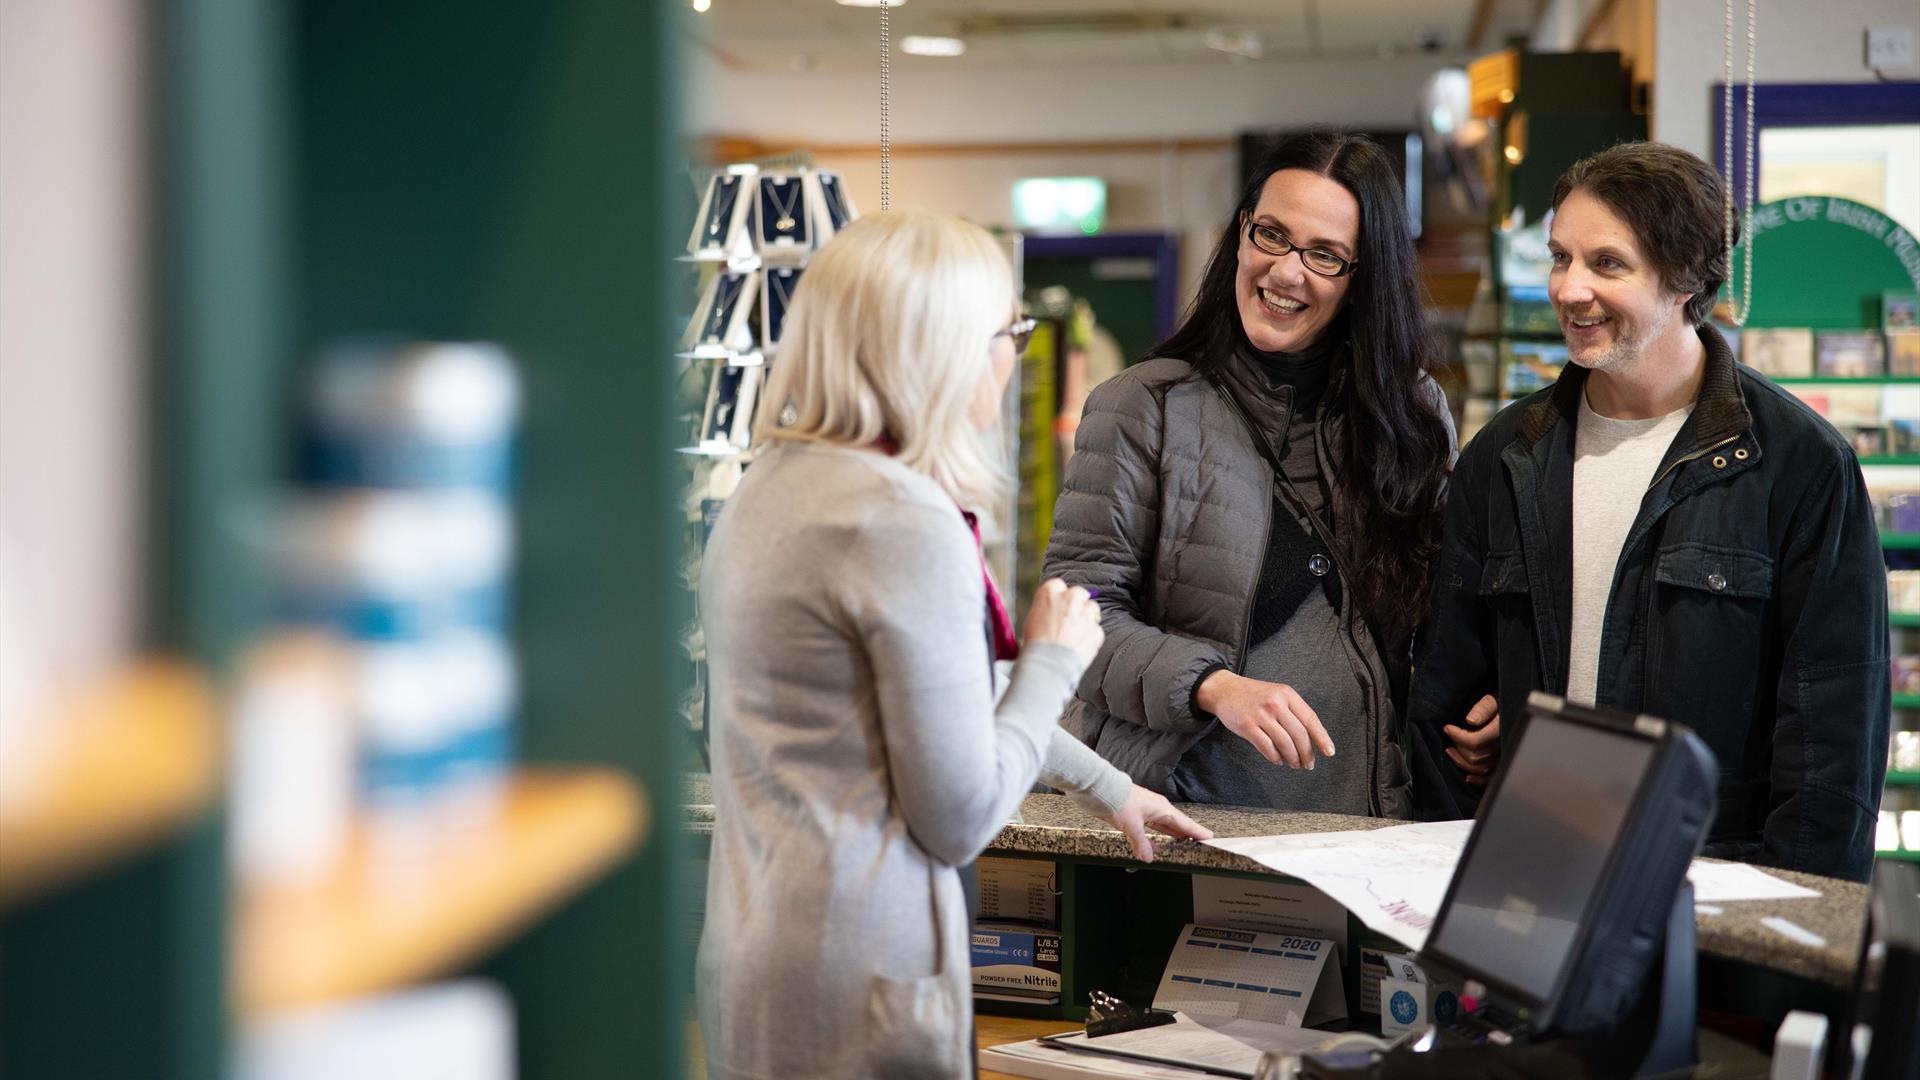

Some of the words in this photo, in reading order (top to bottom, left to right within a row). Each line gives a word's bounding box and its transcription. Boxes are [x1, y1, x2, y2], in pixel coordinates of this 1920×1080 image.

[1784, 198, 1824, 222] OF
[1037, 939, 1059, 948] L/8.5
[1280, 937, 1321, 952] 2020
[980, 975, 1006, 983] POWDER
[1006, 977, 1022, 985] FREE
[1024, 975, 1058, 987] Nitrile
